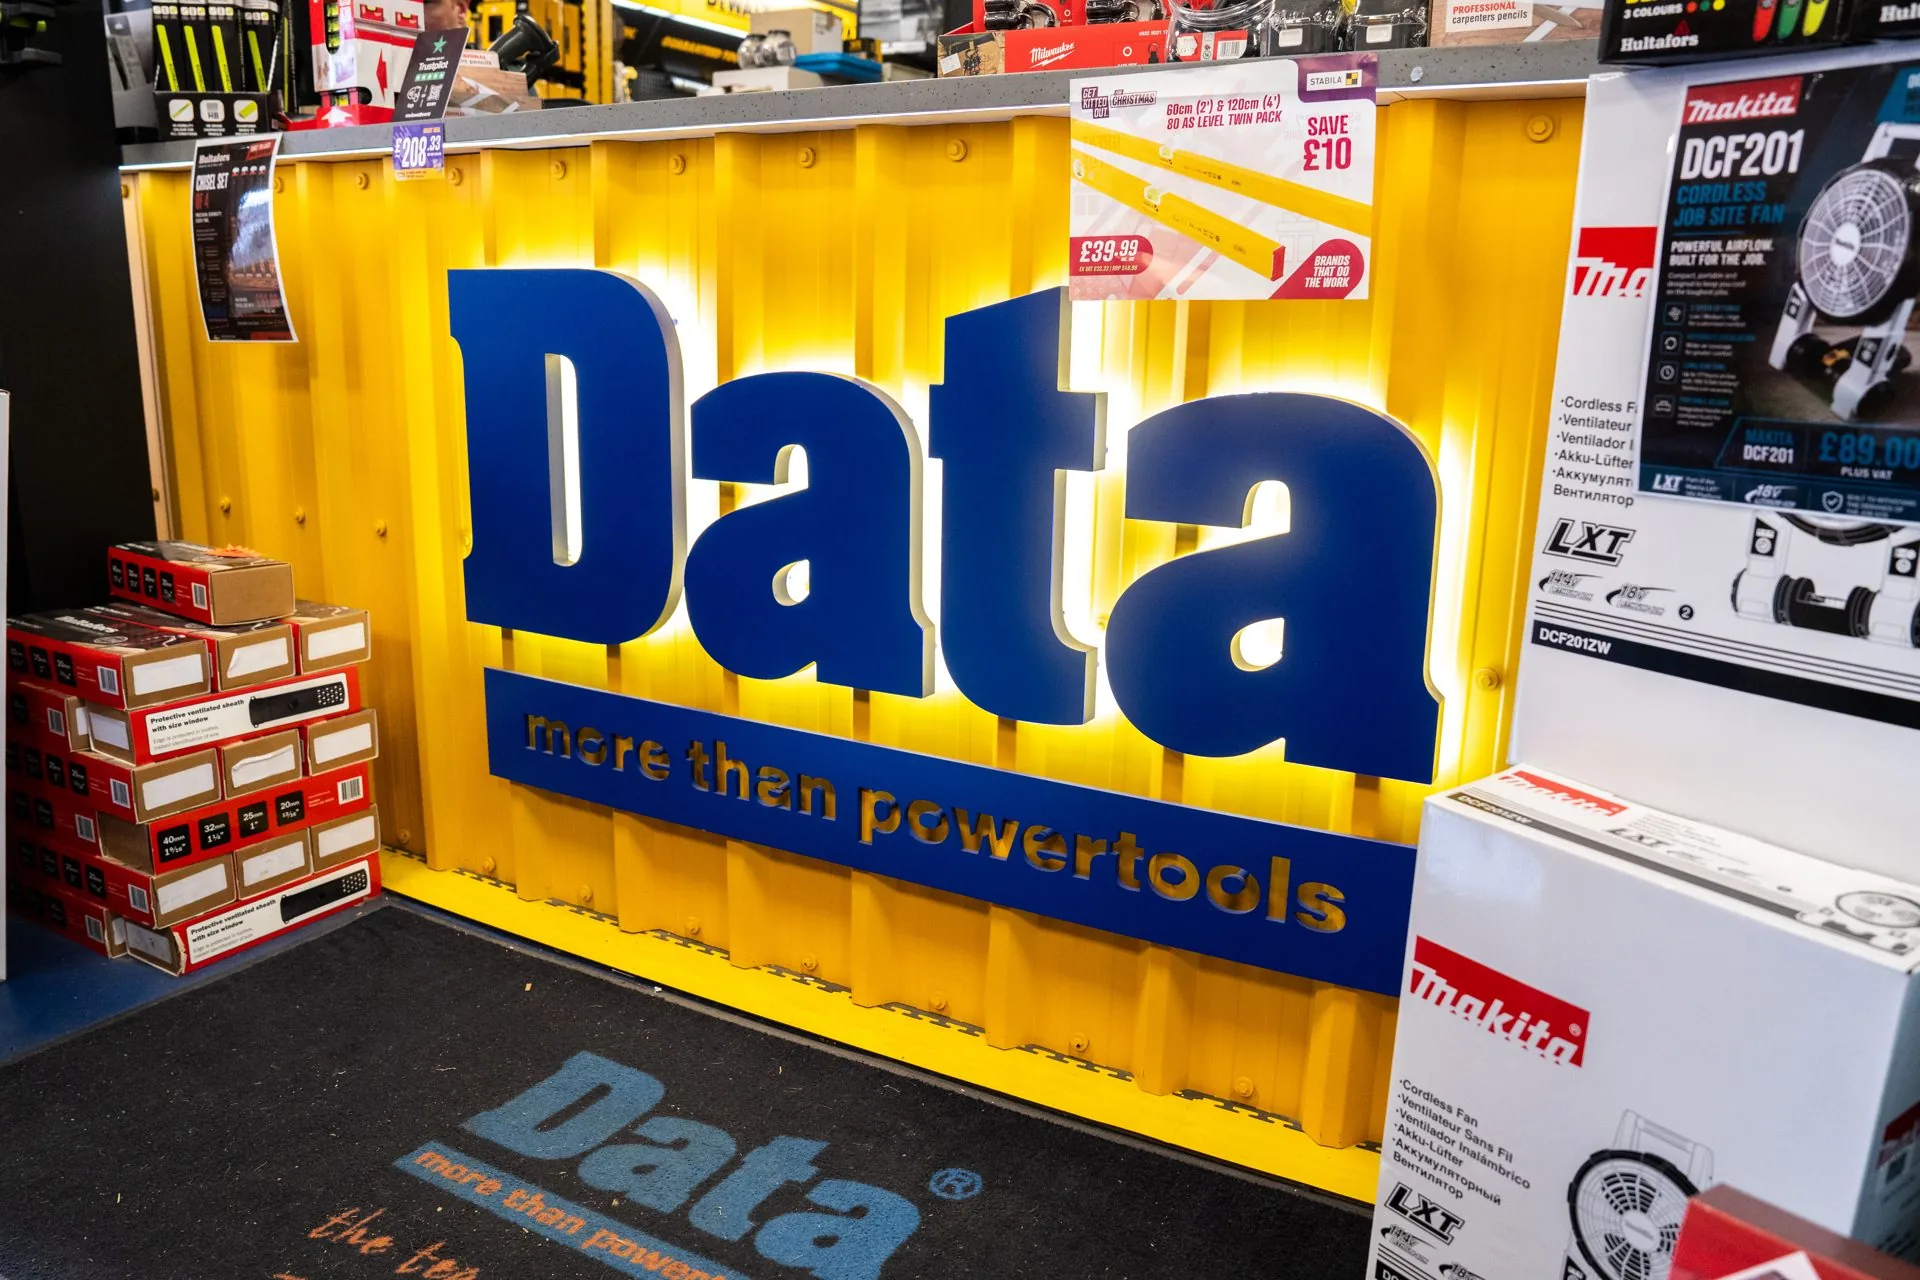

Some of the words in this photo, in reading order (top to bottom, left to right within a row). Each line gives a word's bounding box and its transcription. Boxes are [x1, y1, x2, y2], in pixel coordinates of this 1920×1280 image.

[1452, 12, 1495, 24] carpenters
[1497, 10, 1528, 21] pencils
[1453, 1, 1516, 14] PROFESSIONAL
[1623, 9, 1631, 19] 3
[1632, 3, 1683, 18] COLOURS
[1029, 42, 1075, 63] Milwaukee
[1620, 33, 1699, 52] Hultafors
[419, 61, 448, 71] Trustpilot
[1310, 76, 1342, 85] STABILA
[1083, 88, 1096, 98] GET
[1112, 93, 1154, 106] CHRISTMAS
[1083, 98, 1107, 109] KITTED
[1166, 103, 1192, 116] 60cm
[1217, 100, 1224, 112] &
[1227, 98, 1259, 111] 120cm
[1167, 117, 1179, 130] 80
[1182, 116, 1195, 128] AS
[1197, 114, 1224, 128] LEVEL
[1228, 112, 1252, 126] TWIN
[1256, 110, 1283, 124] PACK
[1308, 115, 1349, 136] SAVE
[1303, 137, 1352, 171] £10
[1680, 129, 1805, 180] DCF201
[217, 172, 229, 189] SET
[1677, 181, 1767, 204] CORDLESS
[1673, 206, 1705, 227] JOB
[1709, 205, 1745, 225] SITE
[1750, 204, 1786, 224] FAN
[1080, 239, 1139, 262] £39.99
[1671, 240, 1723, 252] POWERFUL
[1314, 255, 1350, 266] BRANDS
[1669, 254, 1697, 266] BUILT
[1698, 254, 1719, 266] FOR
[1721, 253, 1740, 265] THE
[1313, 266, 1336, 277] THAT
[1336, 266, 1350, 277] DO
[1305, 277, 1321, 288] THE
[1322, 277, 1350, 288] WORK
[1564, 396, 1622, 412] Cordless
[1563, 413, 1632, 432] Ventilateur
[1561, 431, 1626, 449] Ventilador
[1745, 429, 1794, 446] MAKITA
[1558, 449, 1634, 469] Akku-Lüfter
[1743, 444, 1794, 464] DCF201
[1818, 431, 1920, 470] £89.00
[1652, 473, 1684, 492] LXT
[1840, 466, 1870, 479] PLUS
[1872, 469, 1893, 480] VAT
[1553, 483, 1634, 508] Вентилятор
[448, 268, 1445, 784] Data
[1543, 518, 1636, 567] LXT
[1539, 627, 1612, 655] DCF201ZW
[150, 712, 186, 724] Protective
[187, 704, 221, 716] ventilated
[222, 700, 245, 709] sheath
[152, 723, 167, 733] with
[168, 722, 182, 730] size
[184, 716, 209, 726] window
[280, 800, 300, 810] 20mm
[243, 811, 264, 821] 25mm
[524, 712, 670, 781] more
[686, 740, 837, 821] than
[857, 785, 1348, 934] powertools
[204, 822, 226, 833] 32mm
[163, 834, 186, 845] 40mm
[191, 920, 223, 935] Protective
[224, 908, 254, 922] ventilated
[256, 900, 276, 911] sheath
[192, 934, 206, 943] with
[207, 929, 219, 937] size
[221, 921, 243, 931] window
[1403, 1080, 1453, 1114] Cordless
[1456, 1108, 1478, 1128] Fan
[1402, 1093, 1461, 1134] Ventilateur
[1465, 1129, 1494, 1153] Sans
[1498, 1147, 1513, 1163] Fil
[1398, 1124, 1464, 1167] Akku-Lüfter
[1400, 1108, 1456, 1147] Ventilador
[1459, 1142, 1531, 1189] Inalámbrico
[459, 1051, 921, 1280] Data
[1394, 1151, 1463, 1199] Вентилятор
[1396, 1138, 1502, 1205] Аккумуляторный
[414, 1151, 501, 1196] more
[503, 1189, 586, 1235] than
[1384, 1182, 1465, 1246] LXT
[308, 1207, 393, 1255] the
